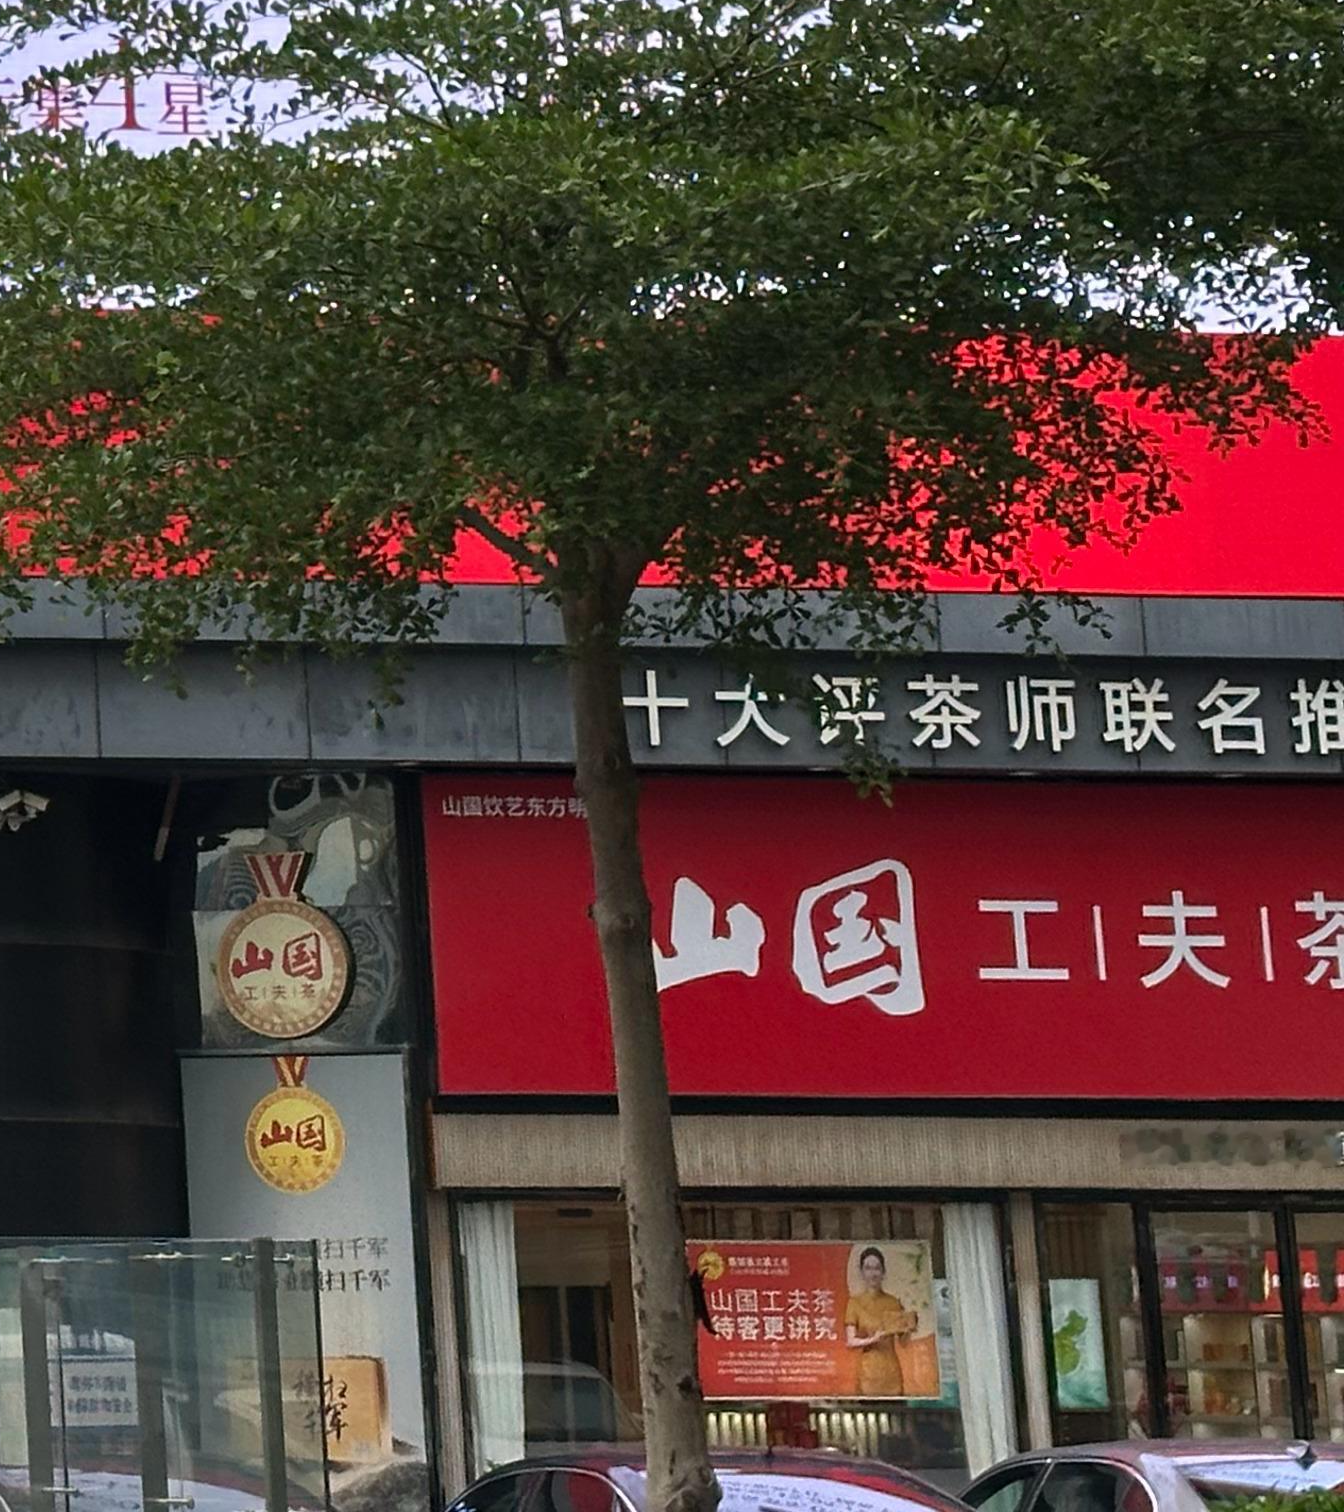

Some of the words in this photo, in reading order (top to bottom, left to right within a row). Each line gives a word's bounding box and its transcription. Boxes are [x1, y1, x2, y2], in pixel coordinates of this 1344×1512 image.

[231, 931, 325, 982] 山国
[260, 1114, 327, 1152] 山国
[712, 1288, 836, 1314] 山国工夫茶
